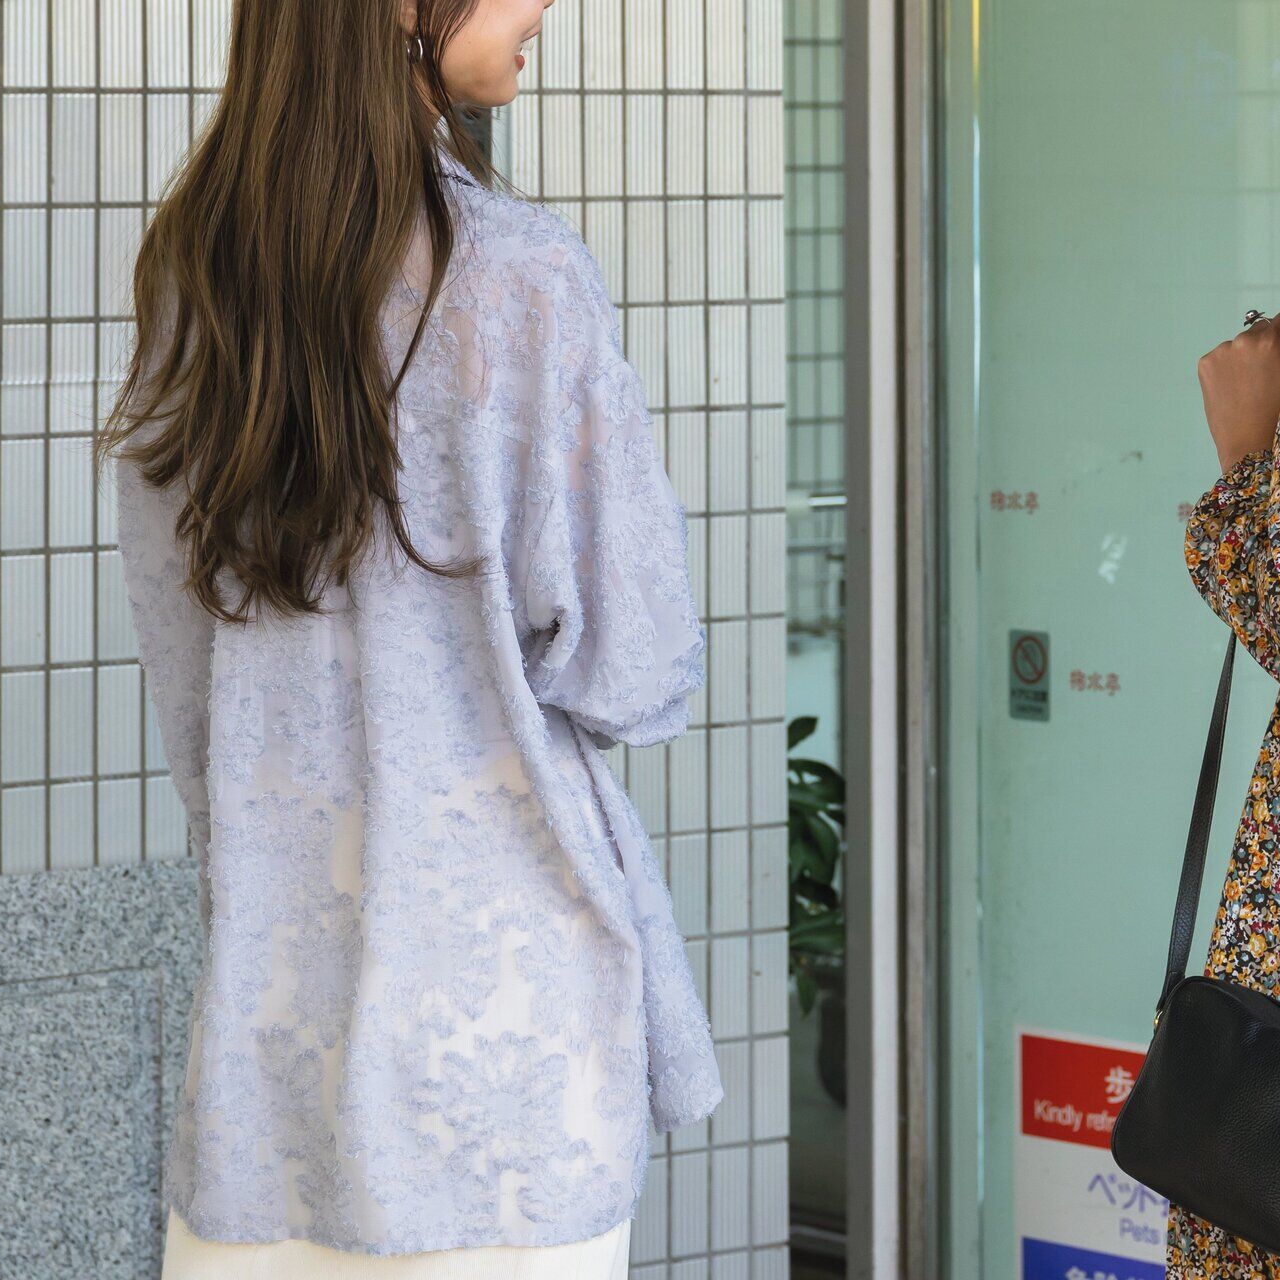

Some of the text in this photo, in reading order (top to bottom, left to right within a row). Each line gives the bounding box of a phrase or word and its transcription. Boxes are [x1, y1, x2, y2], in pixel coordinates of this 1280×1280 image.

[1034, 1099, 1083, 1132] Kindly
[1087, 1173, 1169, 1216] ペット
[1119, 1218, 1160, 1245] Pets
